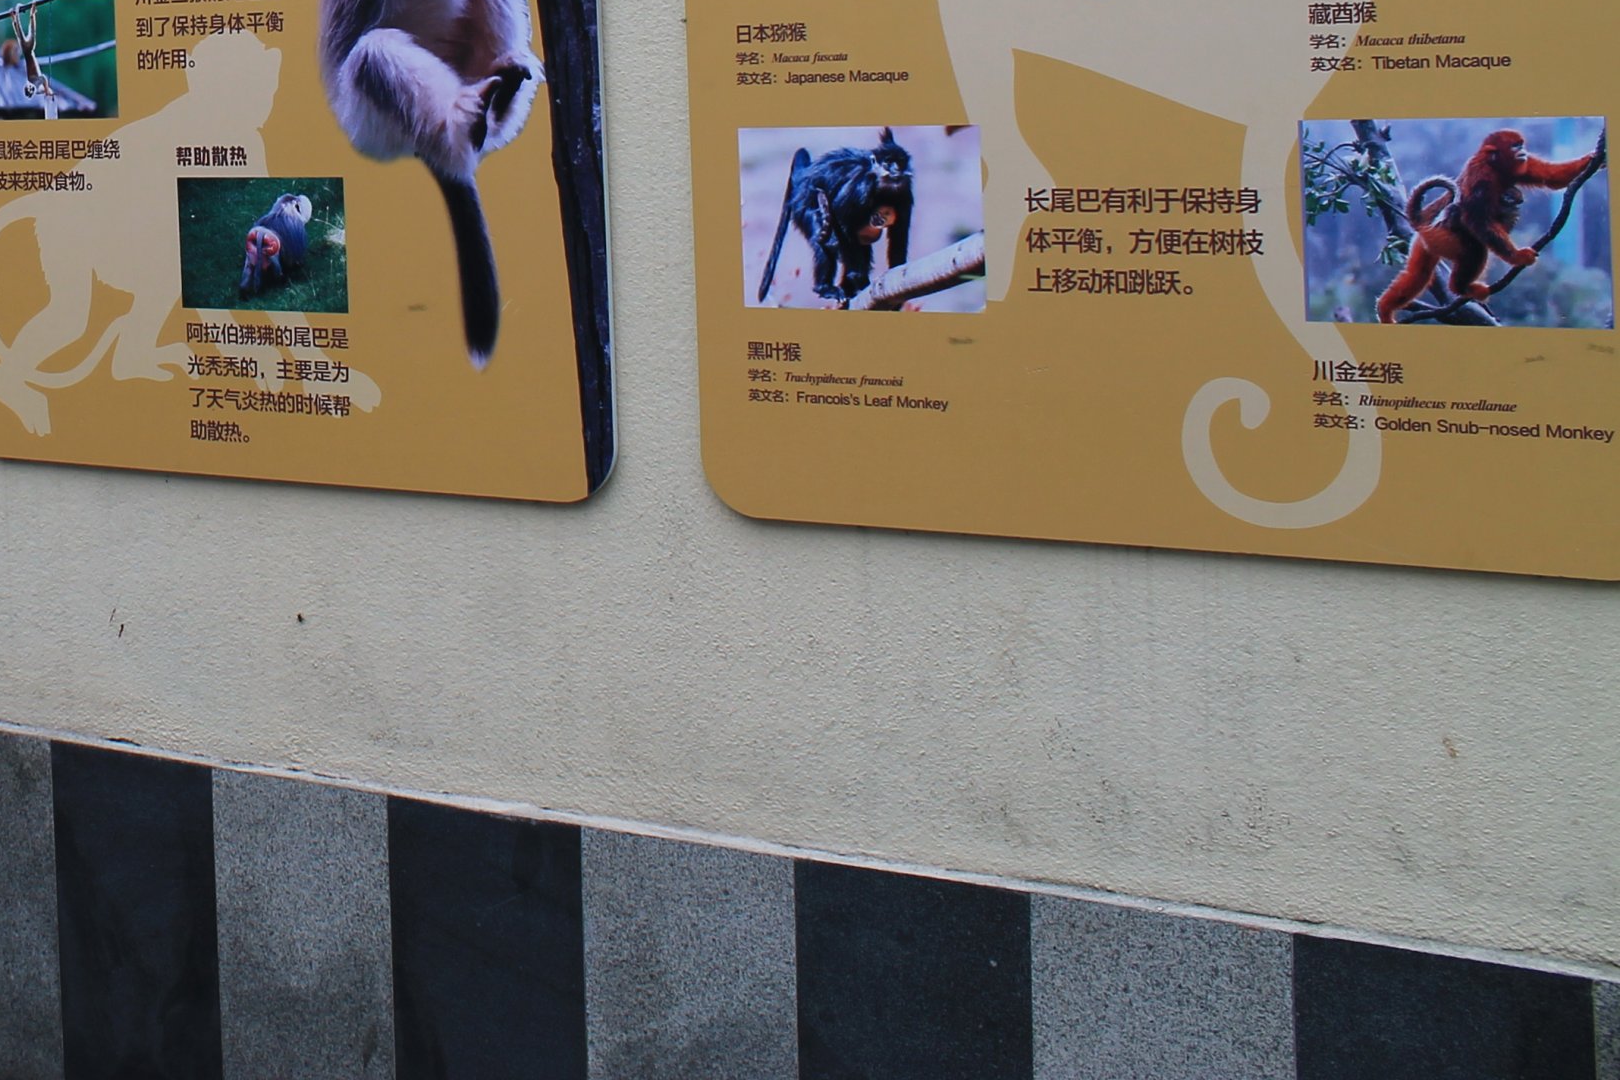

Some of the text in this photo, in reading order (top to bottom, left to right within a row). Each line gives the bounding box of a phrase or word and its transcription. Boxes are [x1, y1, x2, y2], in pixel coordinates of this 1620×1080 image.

[1308, 1, 1377, 25] 藏酋猴
[135, 11, 284, 39] 到了保持身体平衡
[735, 22, 807, 43] 日本猕猴
[1355, 34, 1404, 47] Macaca
[1407, 32, 1465, 46] thibetana
[137, 49, 196, 70] 的作用。
[771, 53, 810, 63] Macaca
[812, 51, 848, 64] fuscata
[1371, 54, 1430, 70] Tibetan
[1435, 53, 1511, 71] Macaque
[784, 71, 845, 85] Japanese
[849, 70, 909, 84] Macaque
[176, 146, 247, 167] 帮助散热
[1024, 186, 1262, 215] 长尾巴有利于保持身
[1026, 228, 1265, 257] 体平衡，方便在树枝
[1027, 268, 1195, 296] 上移动和跳跃。
[186, 322, 349, 350] 阿拉伯狒狒的尾巴是
[747, 341, 801, 362] 黑叶猴
[187, 355, 350, 383] 光秃秃的，主要是为
[784, 371, 858, 386] Trachypithecus
[859, 375, 903, 387] francoisi
[1312, 360, 1403, 384] 川金丝猴
[189, 387, 351, 417] 了天气炎热的时候帮
[796, 391, 860, 406] Francois's
[864, 393, 893, 407] Leaf
[896, 395, 949, 412] Monkey
[1358, 394, 1446, 412] Rhinopithecus
[1450, 397, 1518, 413] roxellanae
[190, 420, 251, 443] 助散热。
[1375, 415, 1432, 434] Golden
[1546, 424, 1615, 444] Monkey
